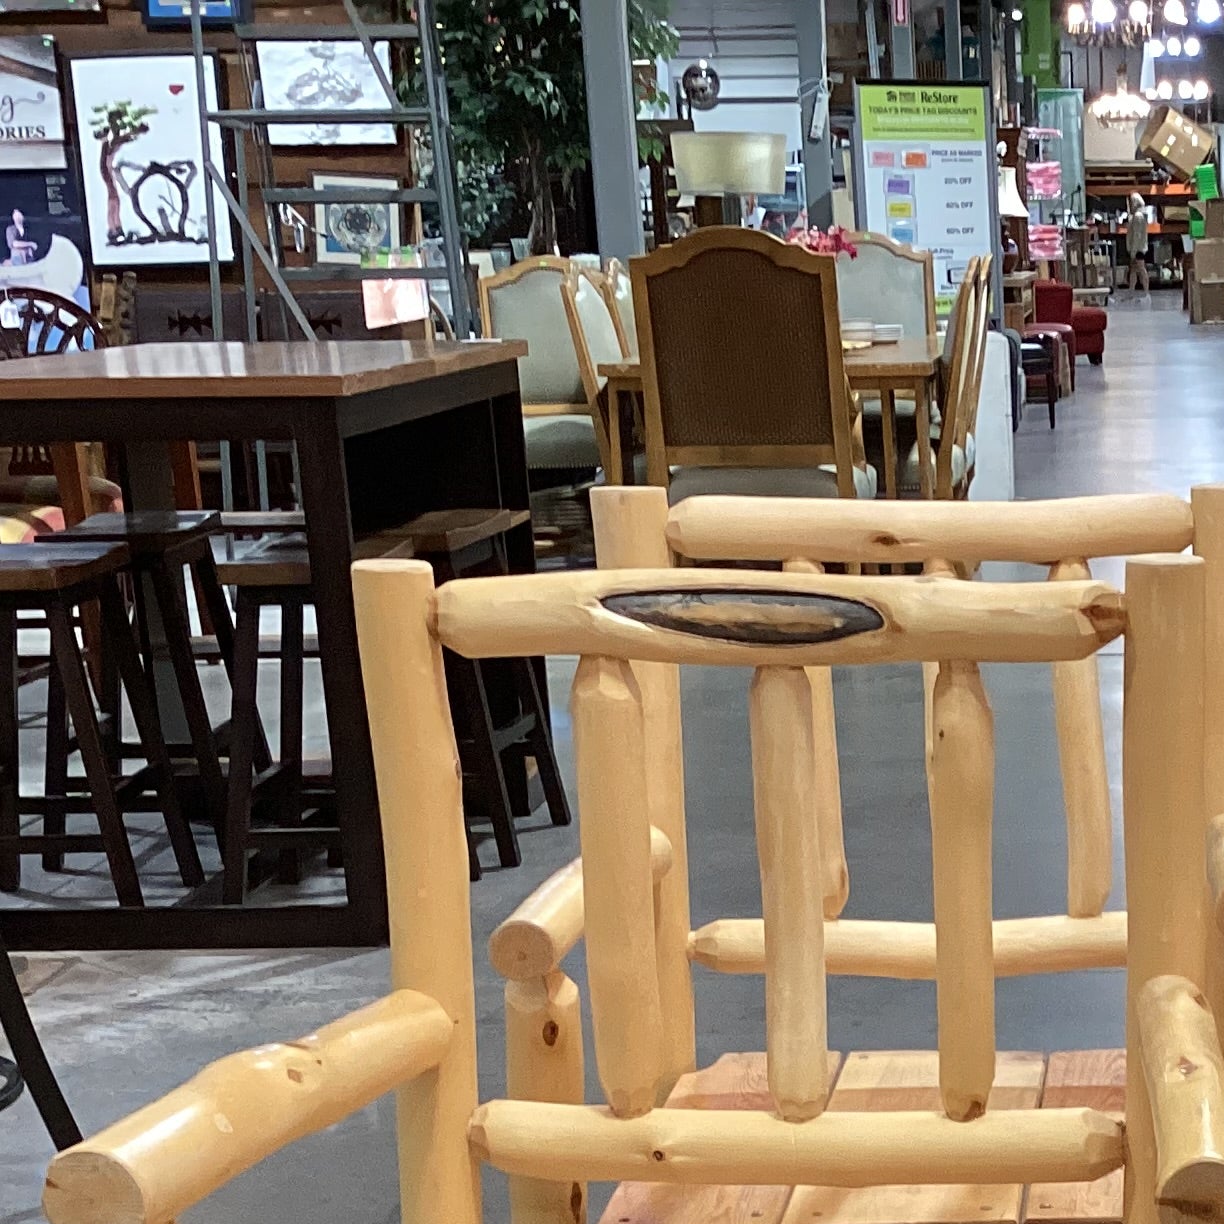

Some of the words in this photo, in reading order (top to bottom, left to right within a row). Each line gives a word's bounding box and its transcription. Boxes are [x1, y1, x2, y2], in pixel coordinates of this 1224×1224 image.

[920, 91, 959, 104] ReStore
[959, 177, 972, 185] OFF
[961, 201, 974, 209] OFF
[962, 227, 975, 235] OFF
